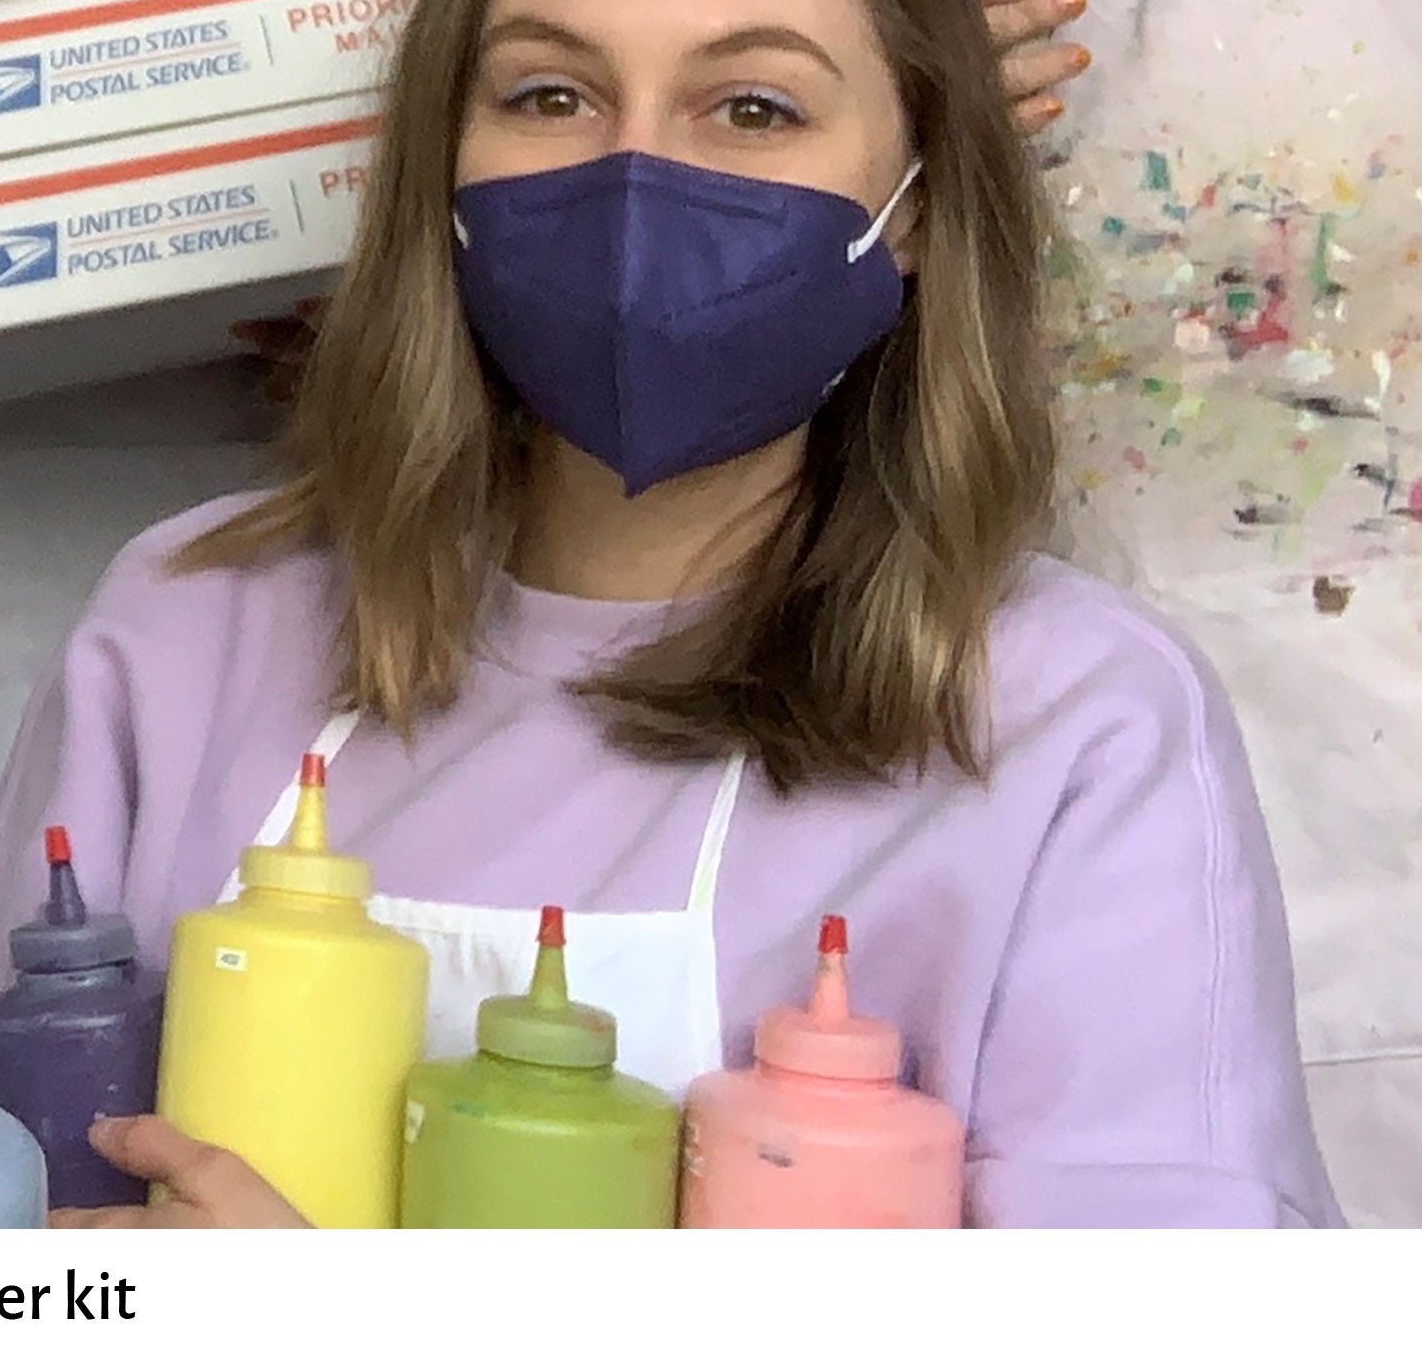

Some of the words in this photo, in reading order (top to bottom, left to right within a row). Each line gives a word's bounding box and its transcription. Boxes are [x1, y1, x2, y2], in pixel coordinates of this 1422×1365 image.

[49, 34, 141, 70] UNITED
[144, 19, 229, 53] STATES
[50, 72, 141, 105] POSTAL
[66, 202, 163, 238] UNITED
[167, 184, 256, 220] STATES
[67, 241, 163, 275] POSTAL
